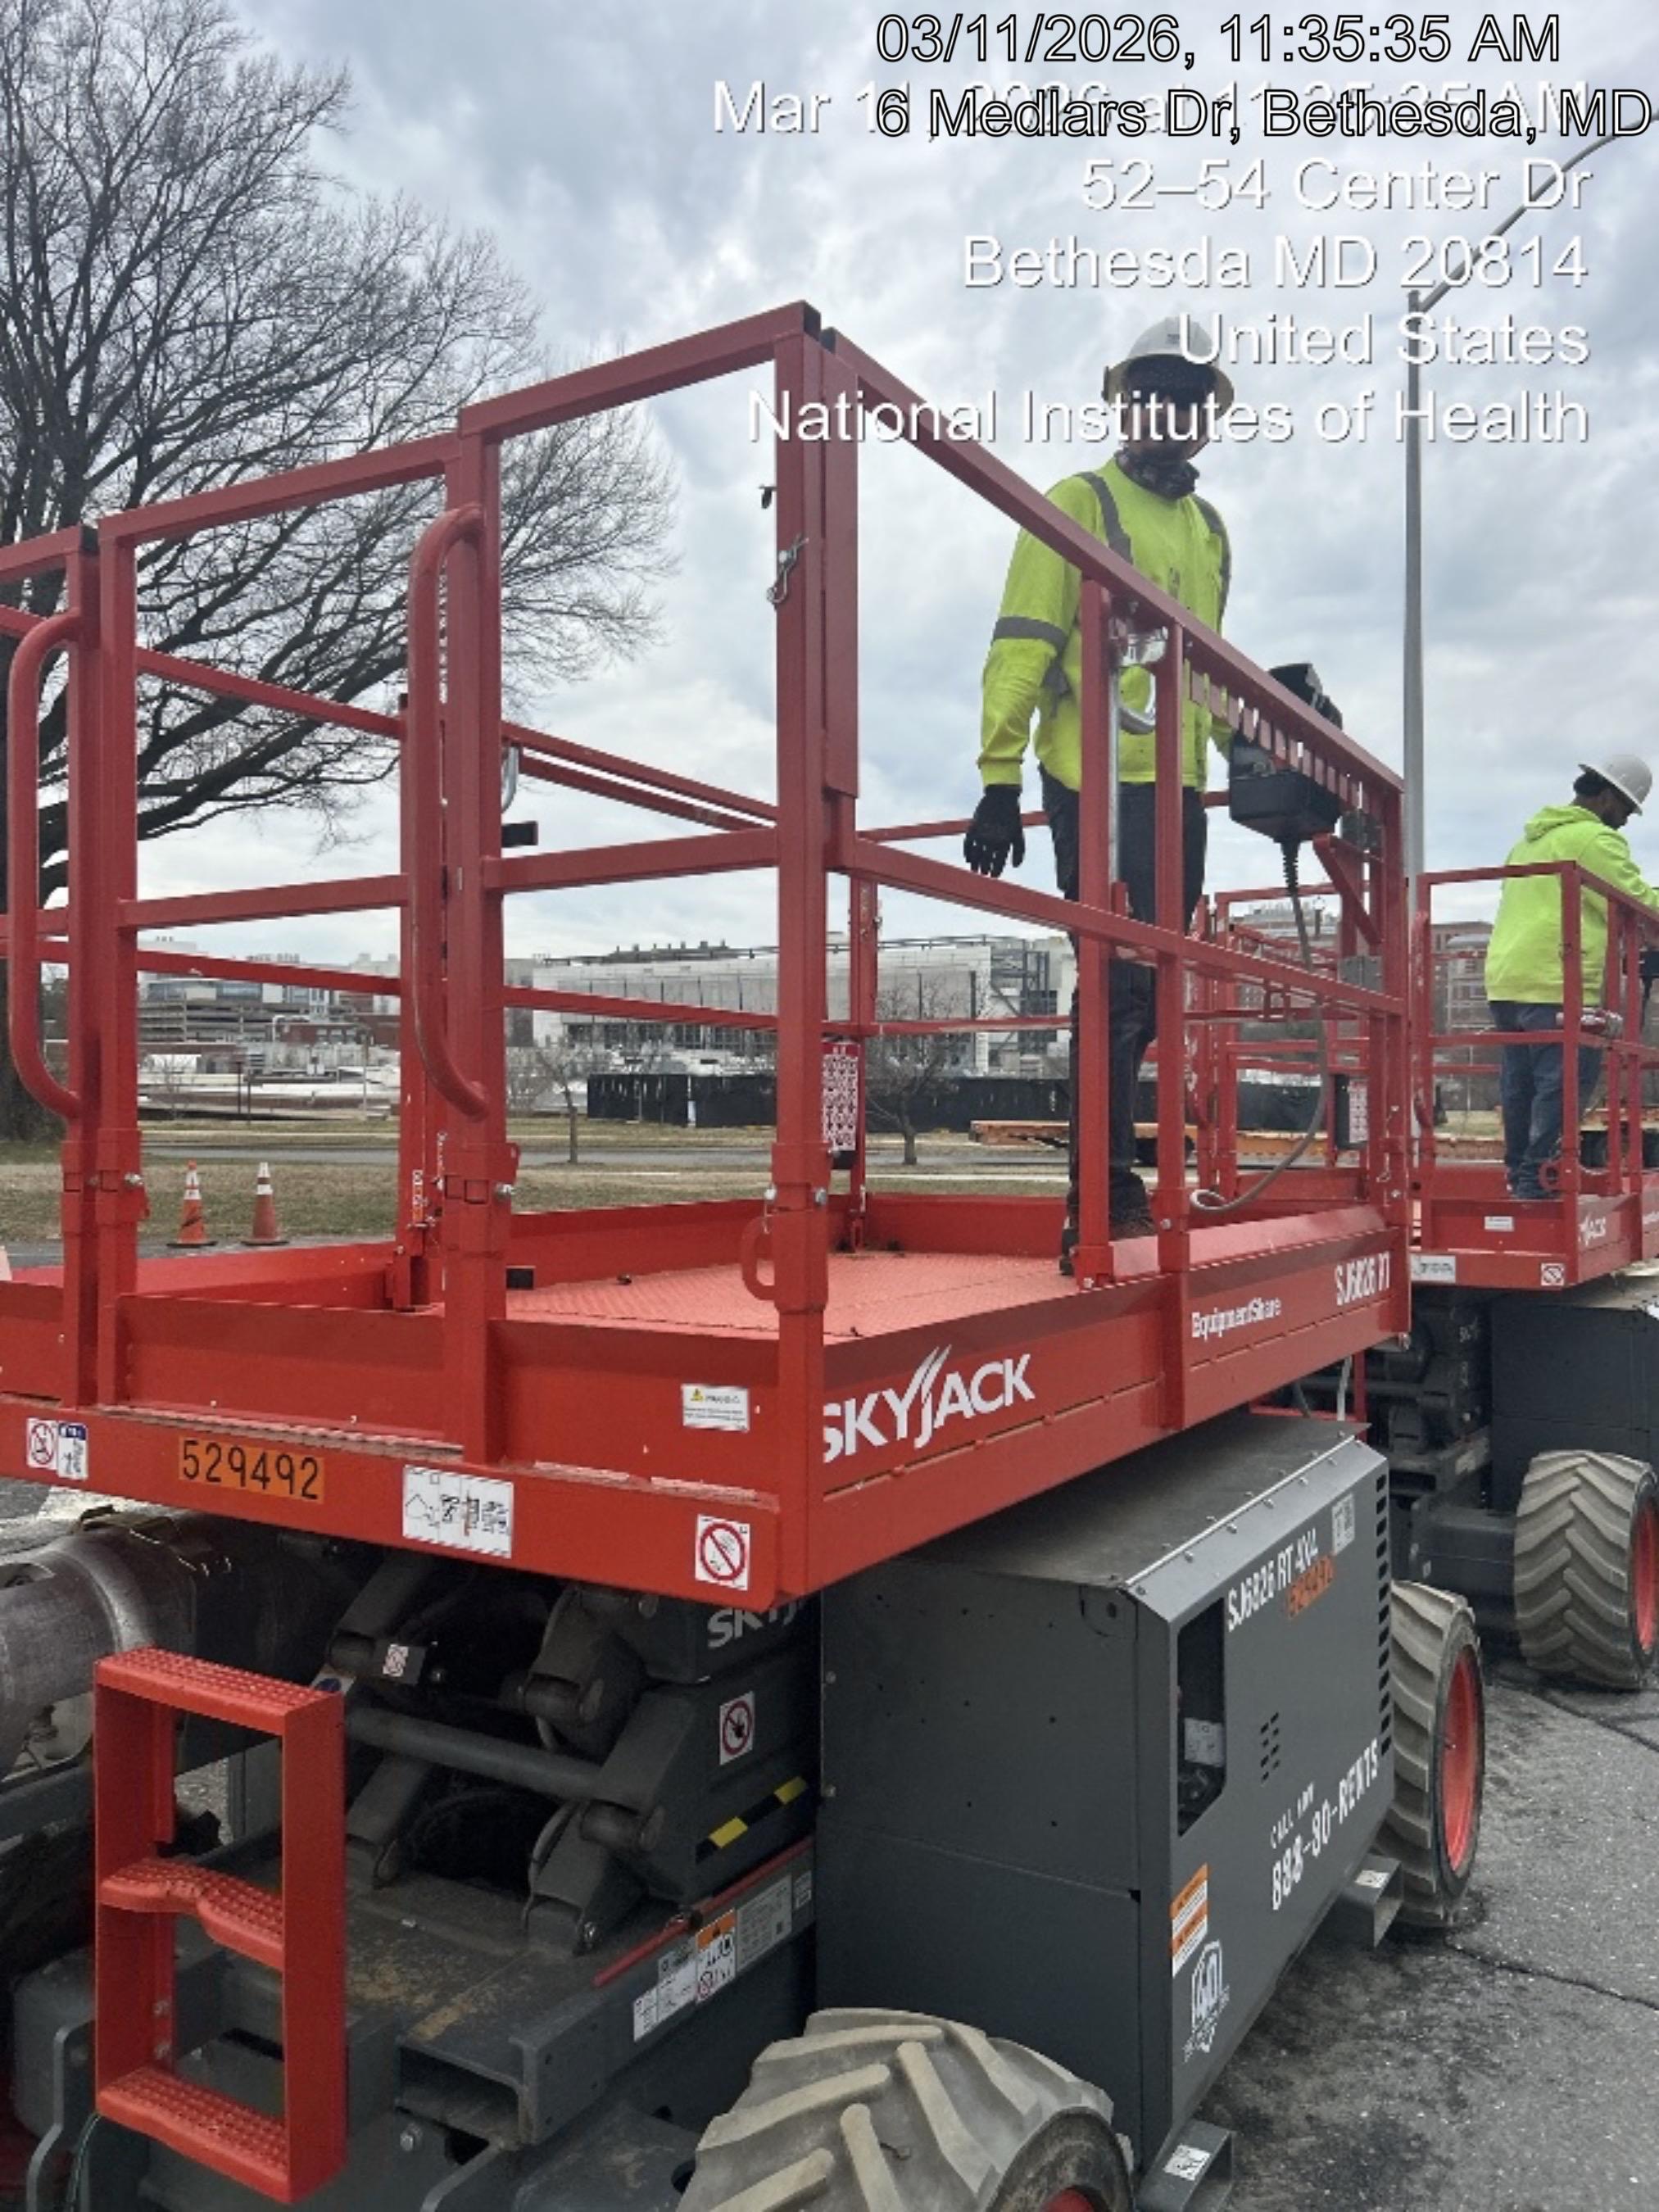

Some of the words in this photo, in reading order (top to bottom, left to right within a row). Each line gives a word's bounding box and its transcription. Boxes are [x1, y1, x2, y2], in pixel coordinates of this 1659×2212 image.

[1191, 1298, 1281, 1342] EquipmentShare
[183, 1439, 319, 1500] 529492
[1277, 1543, 1294, 1591] RT
